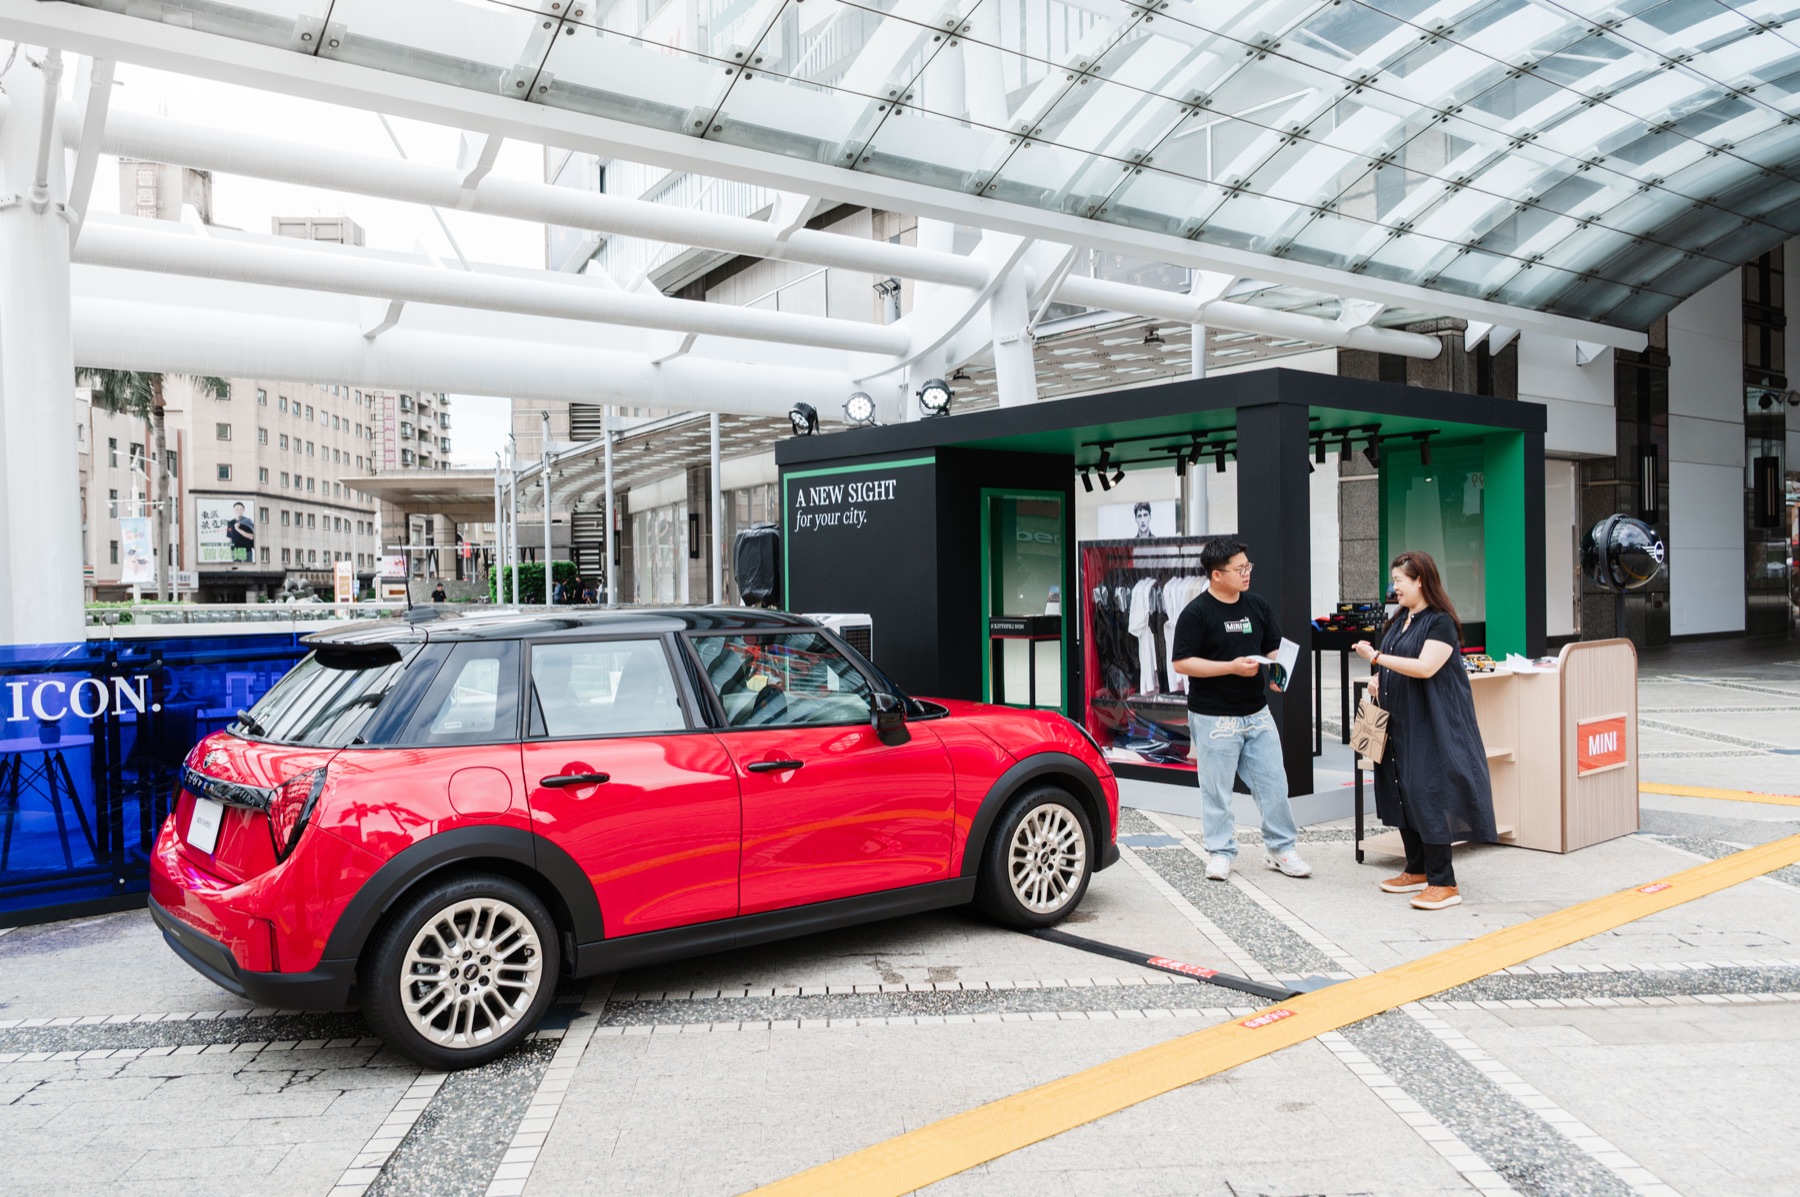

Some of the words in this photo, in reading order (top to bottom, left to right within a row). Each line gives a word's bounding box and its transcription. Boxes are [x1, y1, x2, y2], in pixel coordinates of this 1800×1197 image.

[796, 488, 806, 507] A
[809, 484, 844, 506] NEW
[848, 479, 896, 503] SIGHT
[794, 509, 812, 532] for
[814, 512, 840, 531] your
[843, 507, 867, 528] city.
[6, 675, 161, 722] ICON.
[1588, 731, 1617, 756] MINI
